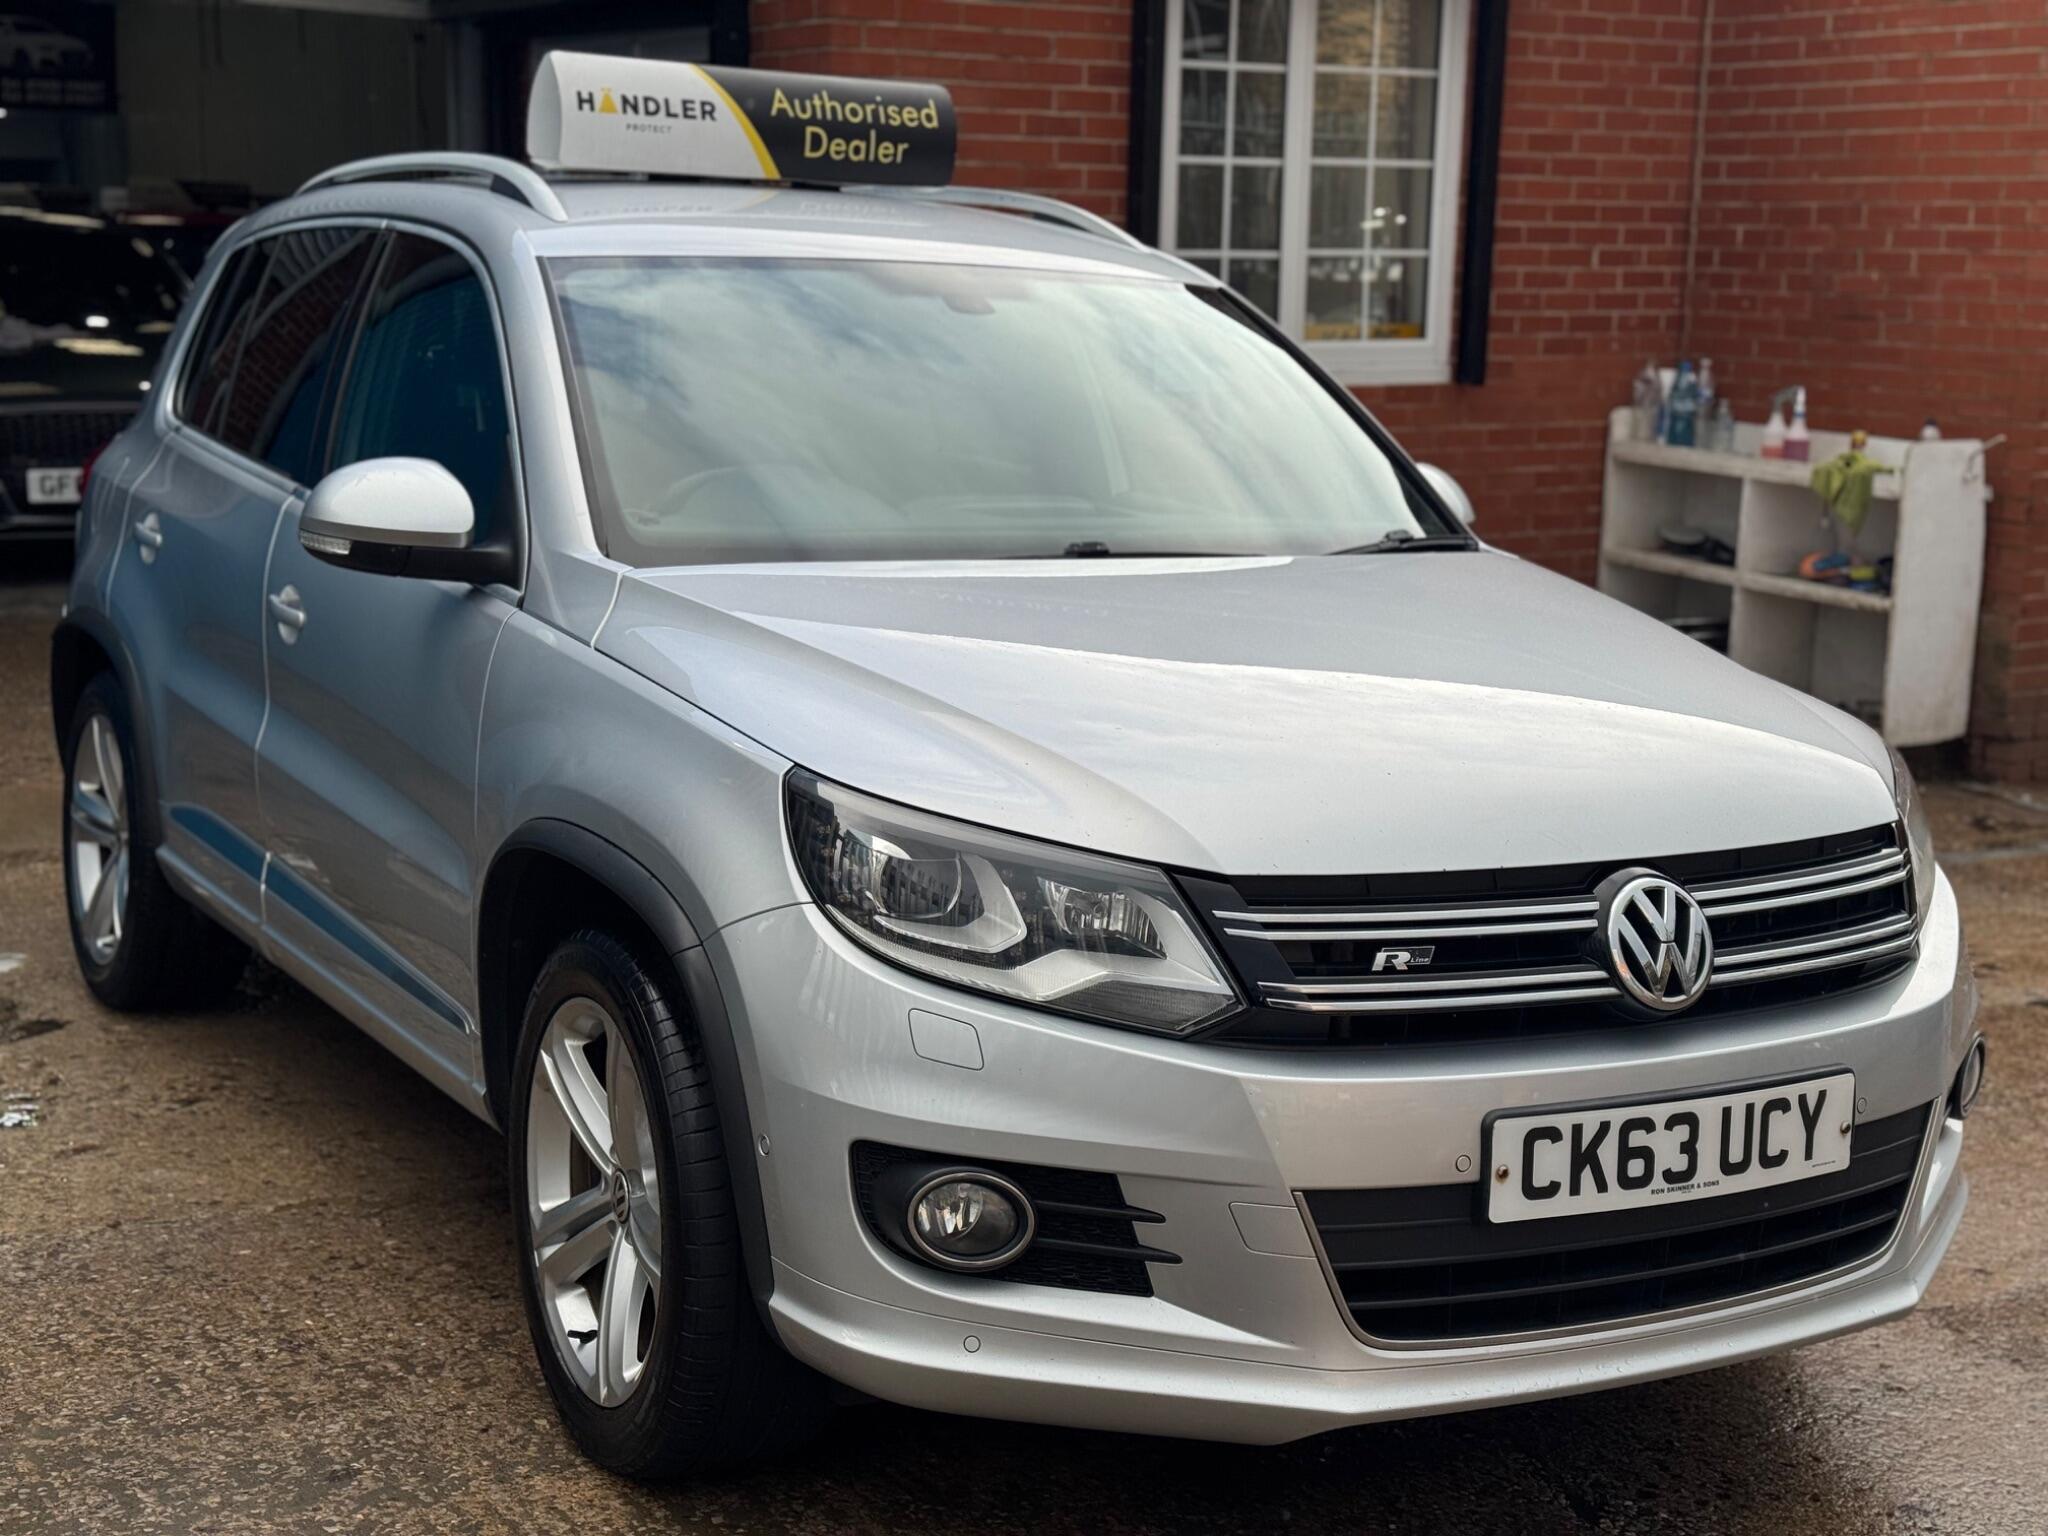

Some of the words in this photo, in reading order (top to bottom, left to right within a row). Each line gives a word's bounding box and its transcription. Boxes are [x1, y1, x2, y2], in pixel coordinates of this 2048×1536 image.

[770, 87, 939, 129] Authorised
[625, 122, 672, 134] PROTECT
[803, 126, 909, 164] Dealer
[1521, 1111, 1700, 1201] CK63
[1719, 1089, 1828, 1177] UCY
[1667, 1184, 1695, 1193] SKINNER
